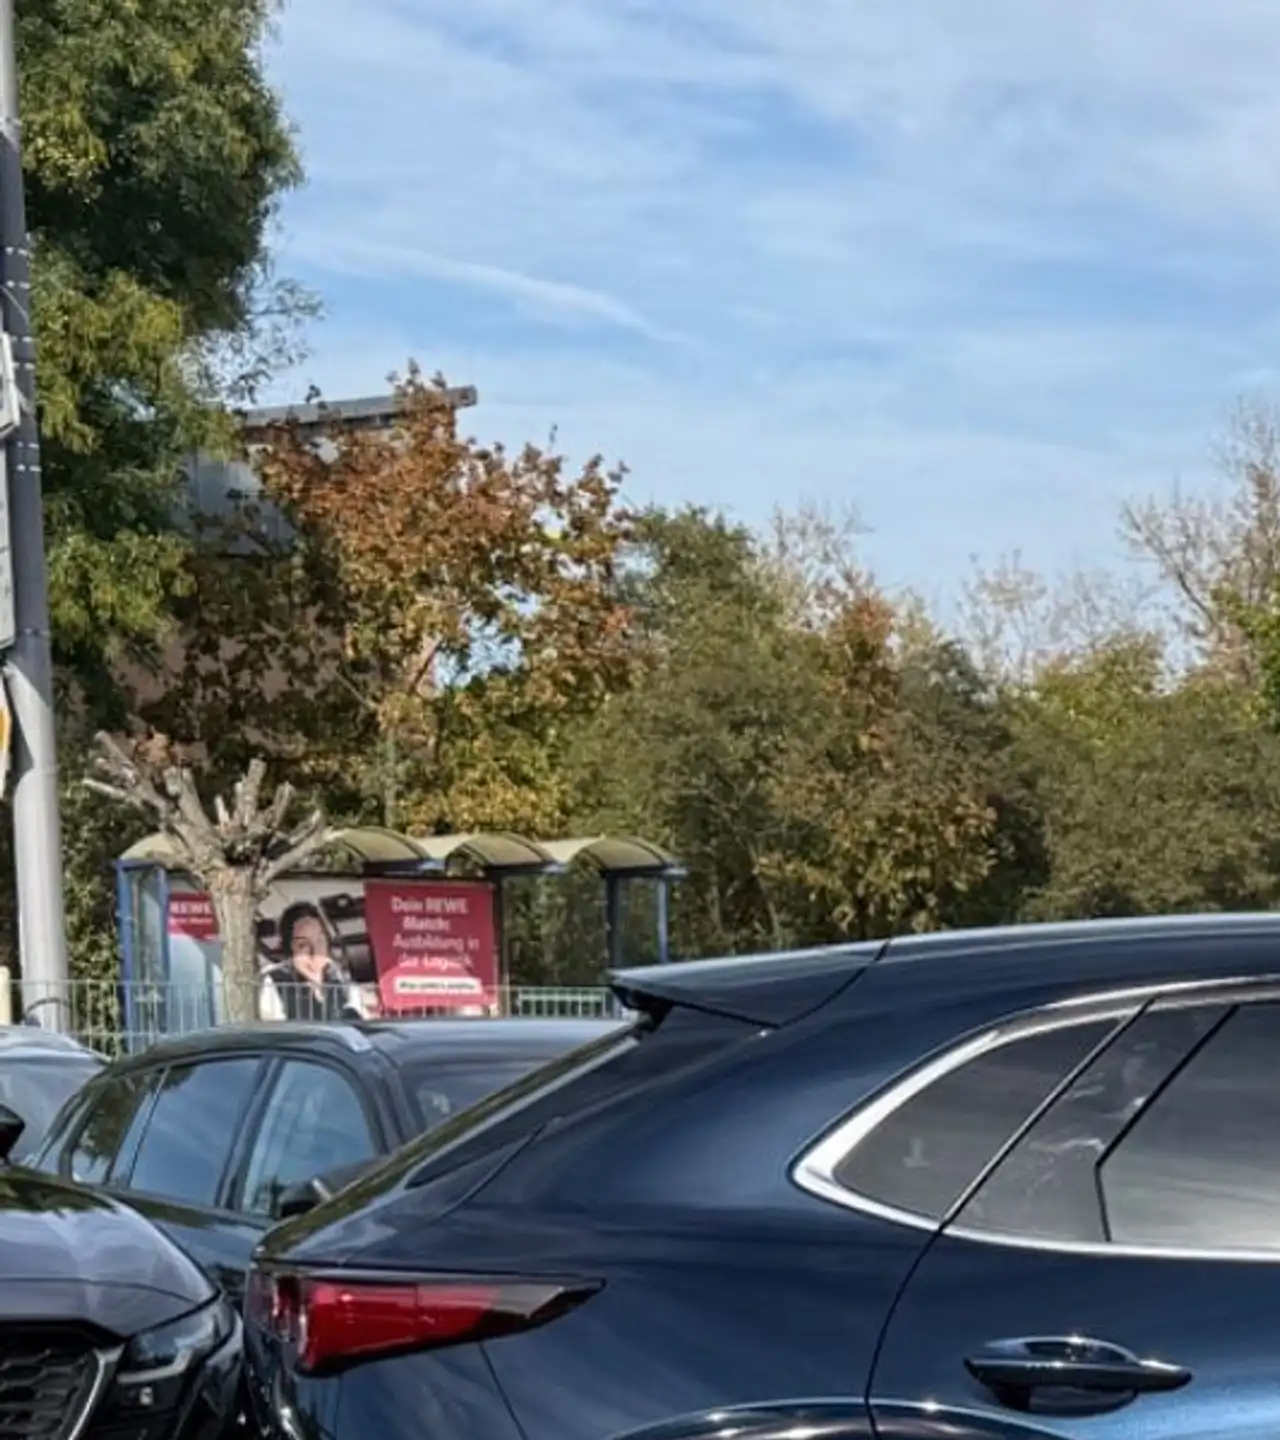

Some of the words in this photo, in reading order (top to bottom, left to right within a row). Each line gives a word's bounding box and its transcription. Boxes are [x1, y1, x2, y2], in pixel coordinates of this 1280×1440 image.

[391, 896, 424, 912] Dein
[425, 897, 469, 914] REWE
[392, 933, 464, 952] Ausbildung
